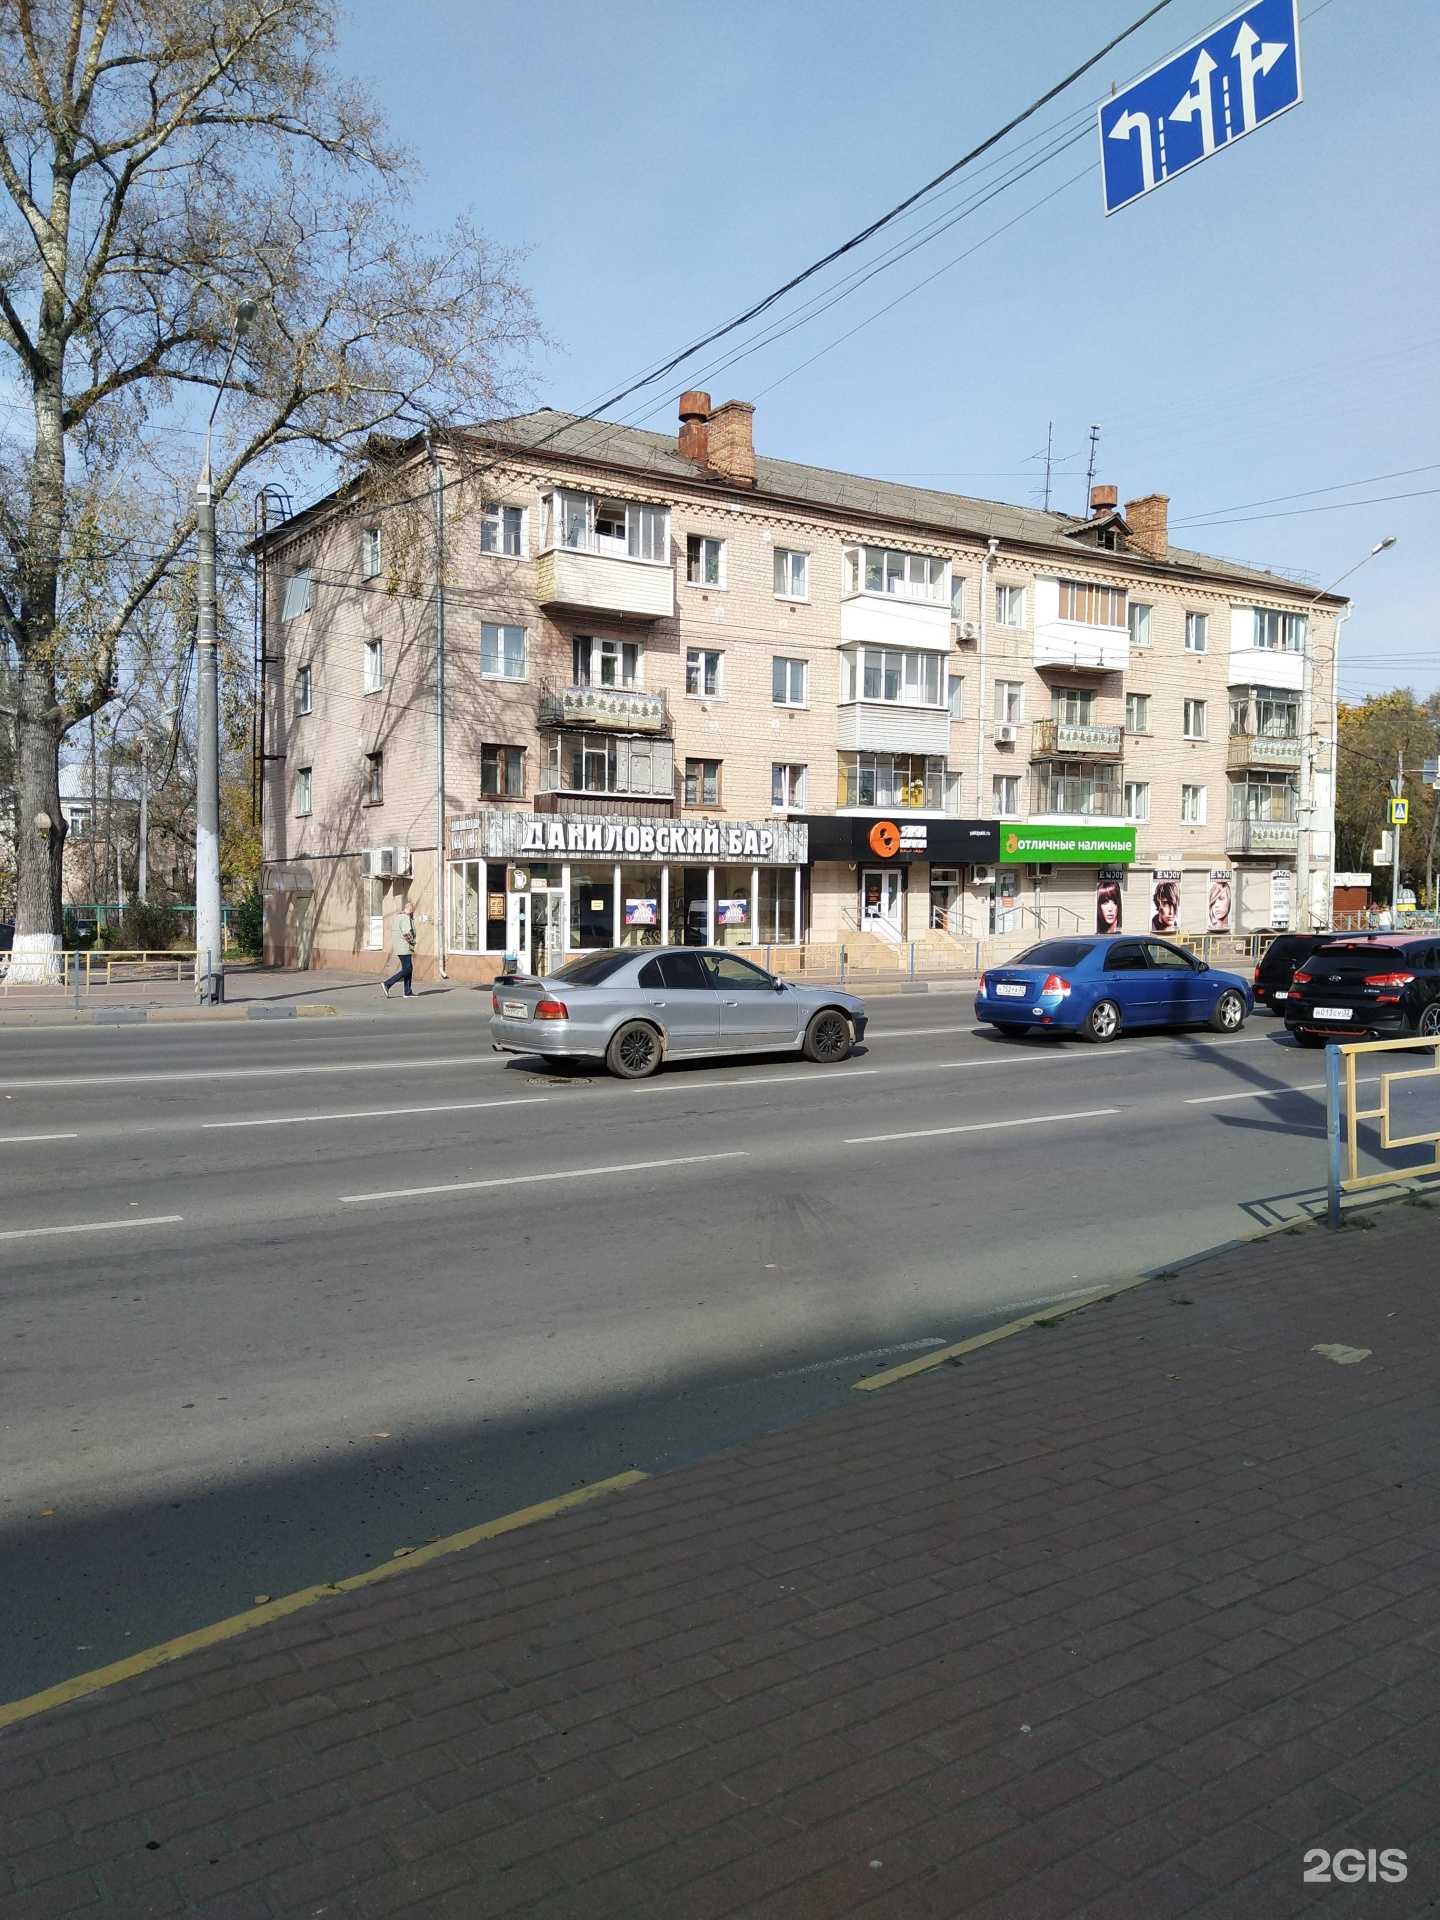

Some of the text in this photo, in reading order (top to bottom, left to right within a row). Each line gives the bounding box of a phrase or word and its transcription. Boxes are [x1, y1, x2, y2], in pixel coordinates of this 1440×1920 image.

[521, 821, 773, 855] ДАНИЛОВСКИЙ БАР
[1018, 839, 1132, 851] отличные наличные
[1157, 871, 1181, 879] ENJOY
